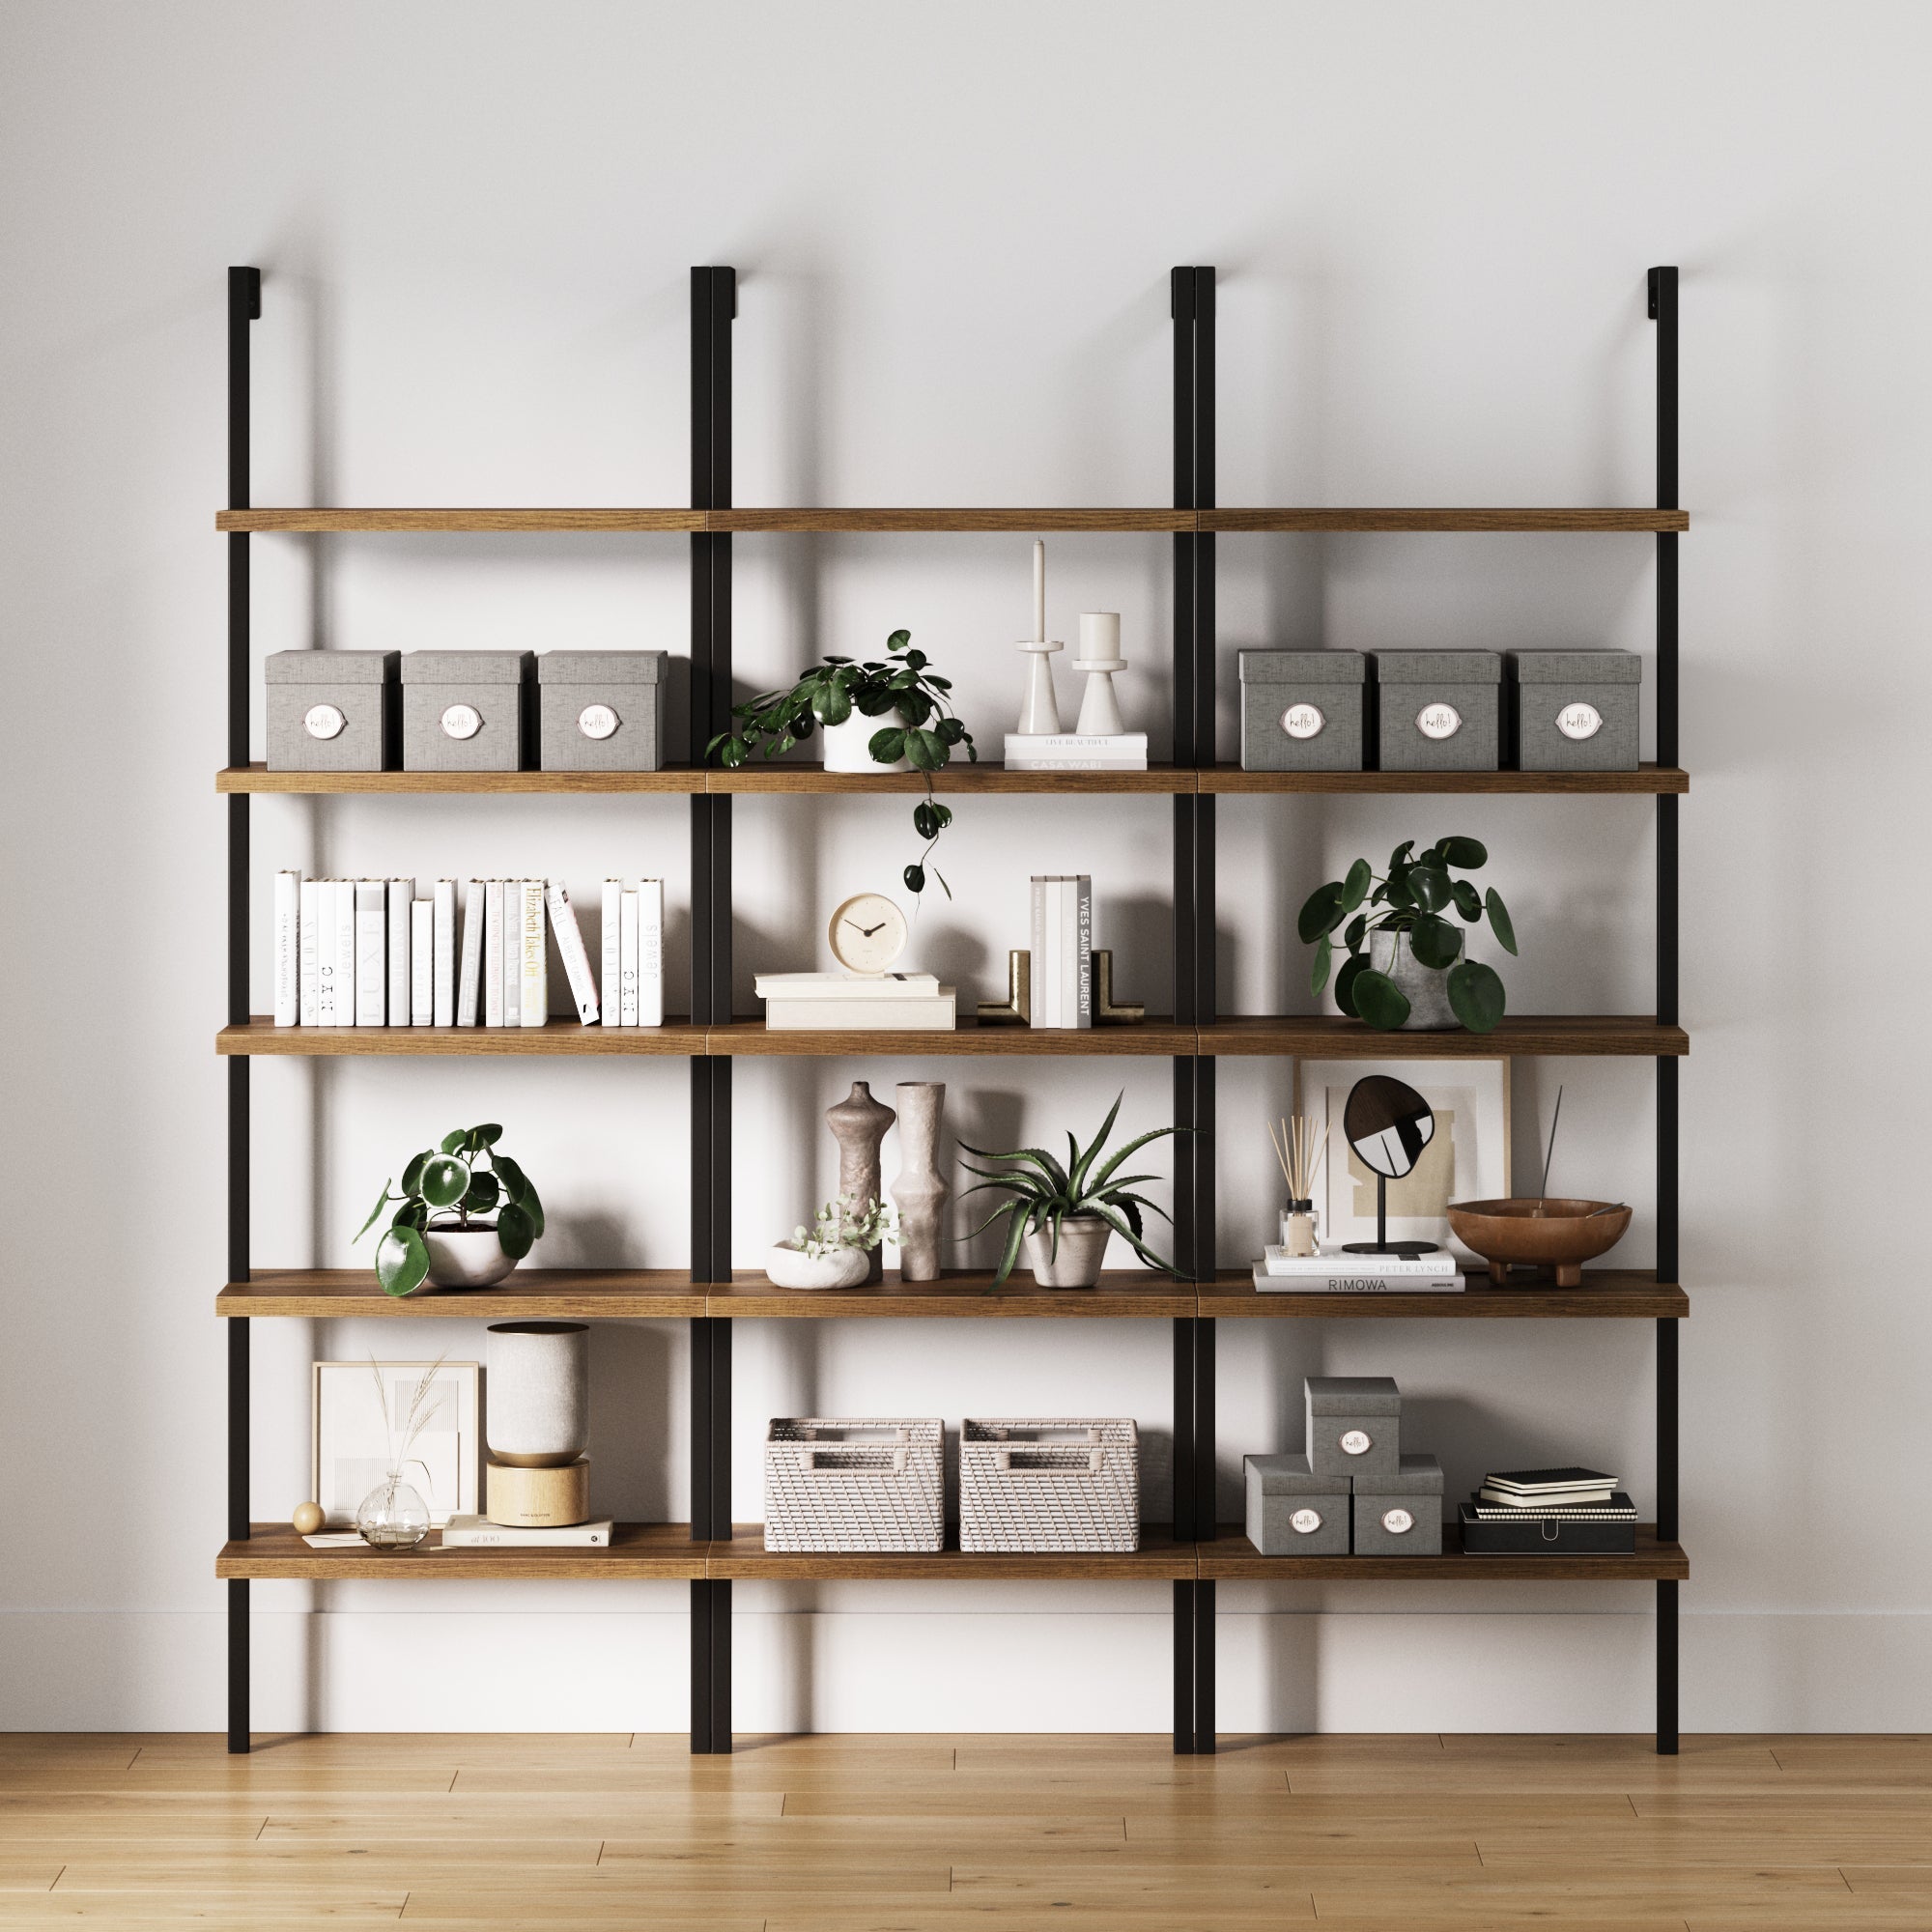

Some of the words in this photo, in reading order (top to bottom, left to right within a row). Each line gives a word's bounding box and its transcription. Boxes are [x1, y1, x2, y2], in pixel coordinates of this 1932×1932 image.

[1290, 713, 1316, 729] hello!
[1426, 713, 1452, 729] hello!
[1566, 713, 1592, 729] hello!
[526, 888, 541, 932] Elizabeth
[1080, 896, 1090, 925] YVES
[526, 934, 541, 959] Takes
[1080, 928, 1090, 961] SAINT
[526, 961, 541, 977] Off
[1080, 965, 1090, 1015] LAURENT
[1328, 1279, 1387, 1292] RIMOWA
